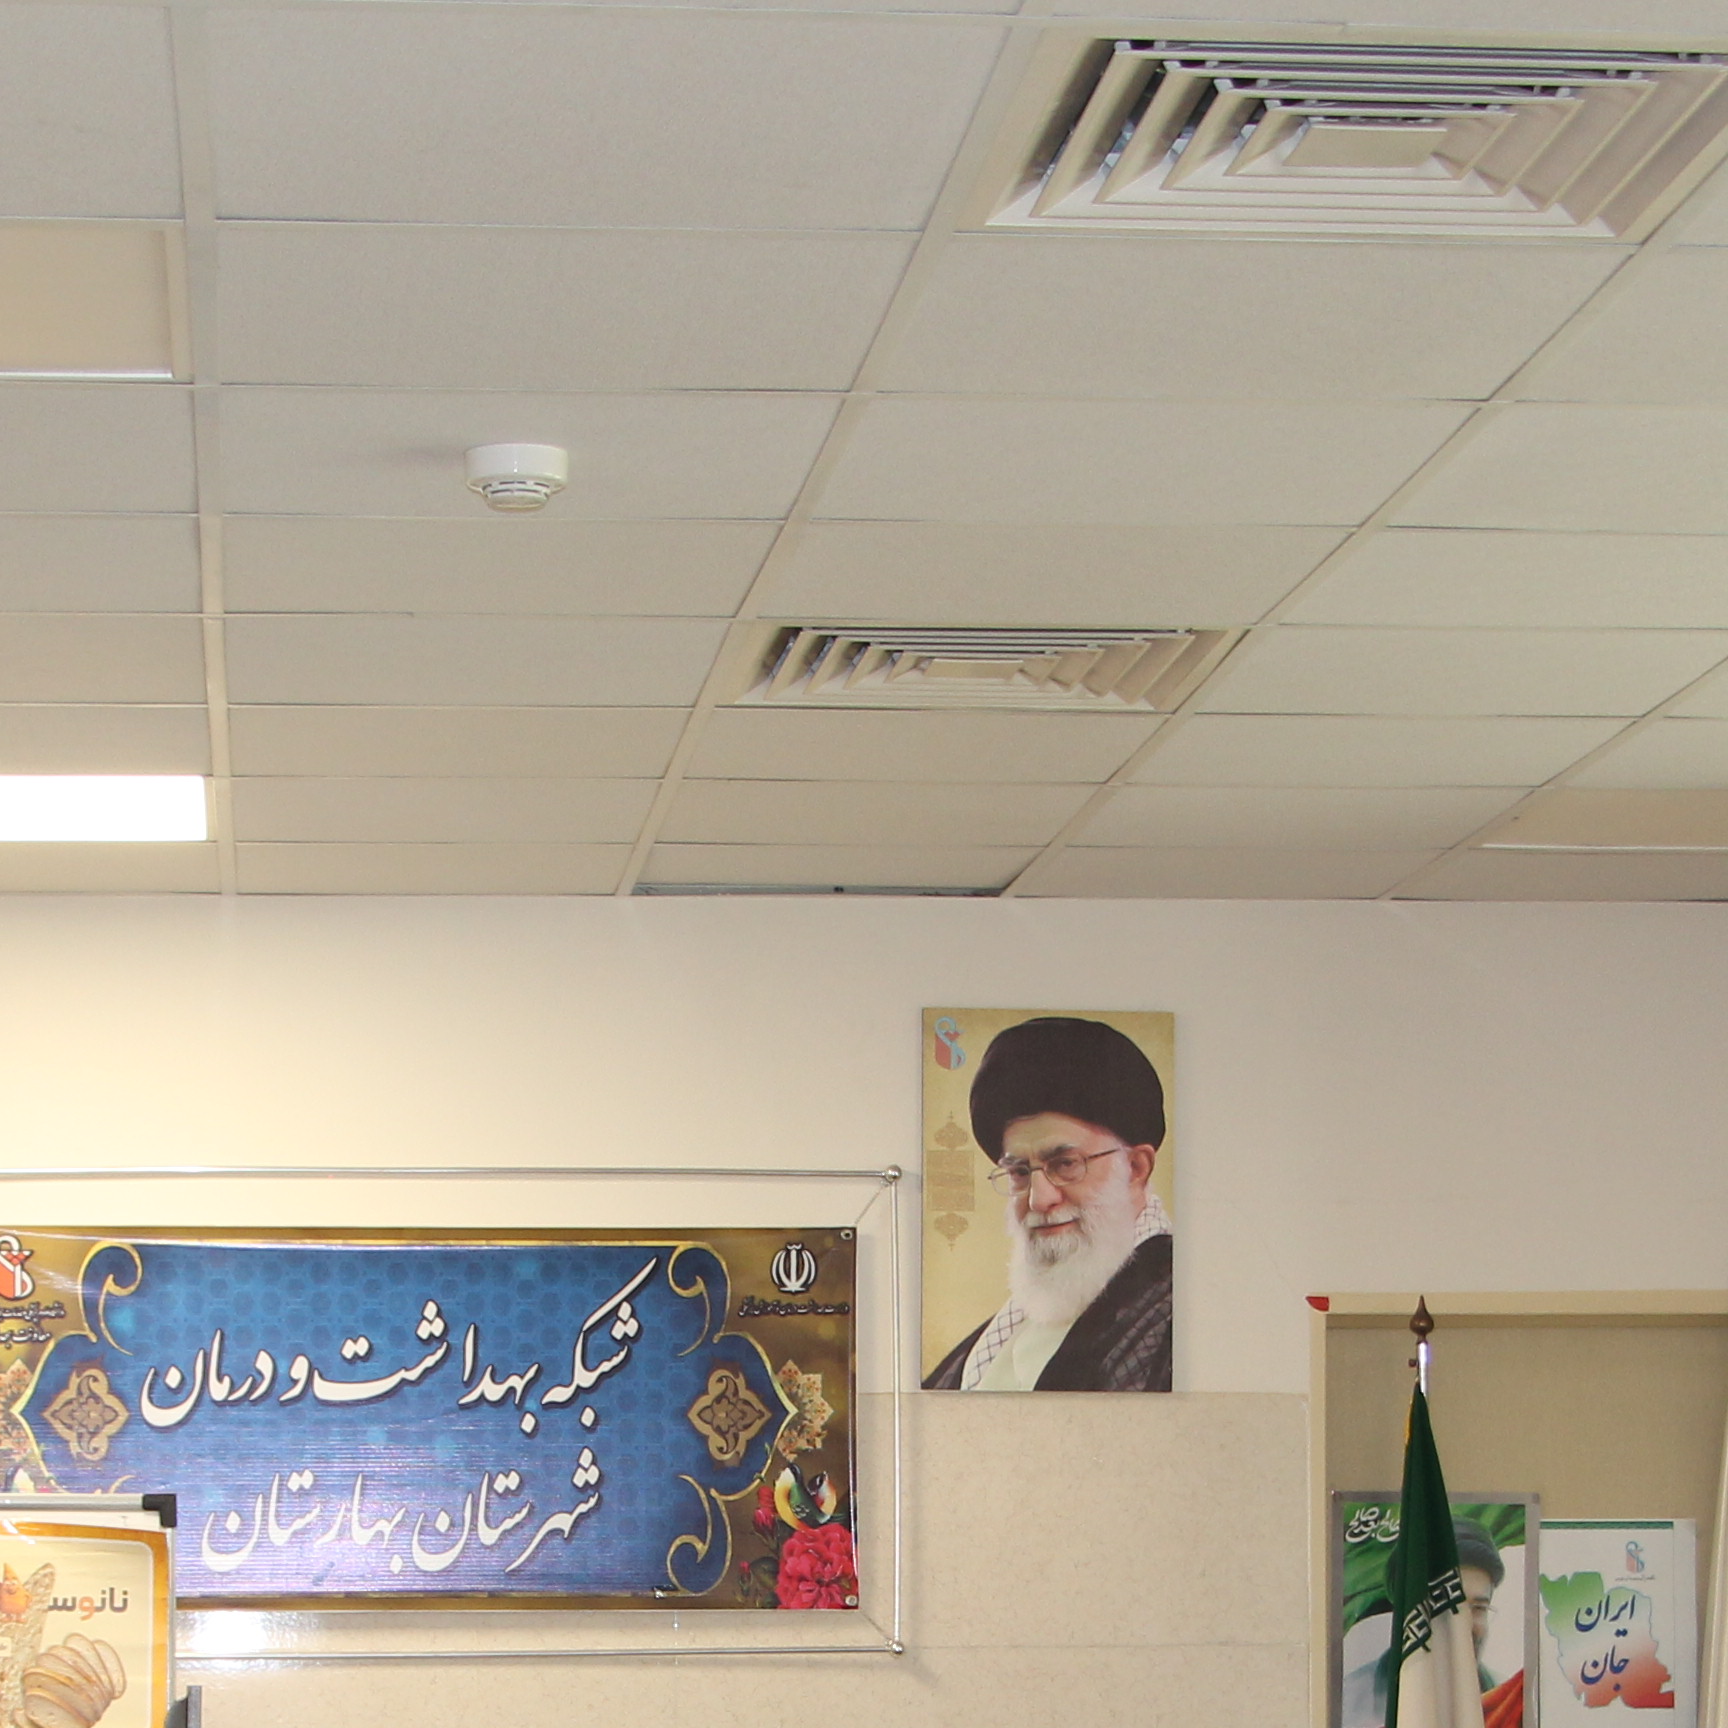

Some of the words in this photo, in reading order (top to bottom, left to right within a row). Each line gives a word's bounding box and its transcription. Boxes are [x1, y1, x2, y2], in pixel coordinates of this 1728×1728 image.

[140, 1328, 273, 1428] درمان
[279, 1354, 311, 1402] و
[312, 1299, 540, 1434] بهداشت
[541, 1257, 657, 1427] شبکه
[201, 1469, 406, 1574] بهارستان
[411, 1447, 601, 1573] شهرستان
[1574, 1593, 1636, 1637] ایران
[1580, 1645, 1630, 1691] جان
